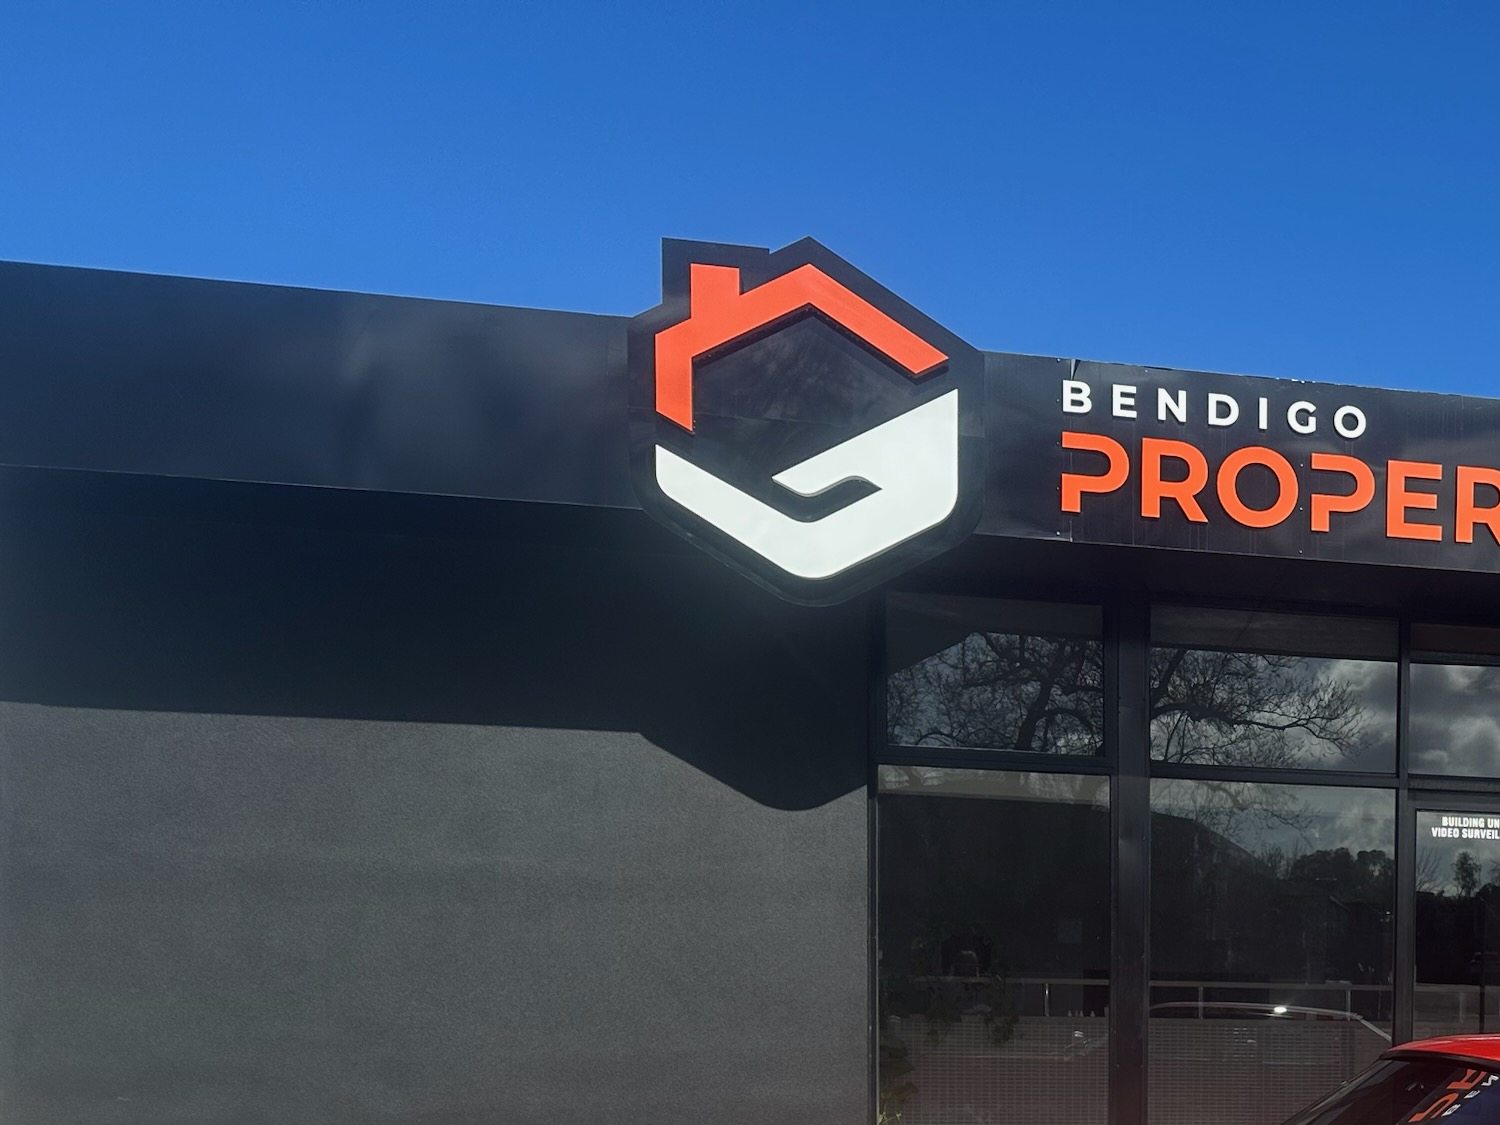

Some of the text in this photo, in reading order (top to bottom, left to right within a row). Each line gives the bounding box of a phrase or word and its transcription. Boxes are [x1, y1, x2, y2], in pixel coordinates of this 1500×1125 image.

[1061, 379, 1367, 439] BENDIGO
[1441, 816, 1485, 829] BUILDING
[1431, 827, 1460, 839] VIDEO
